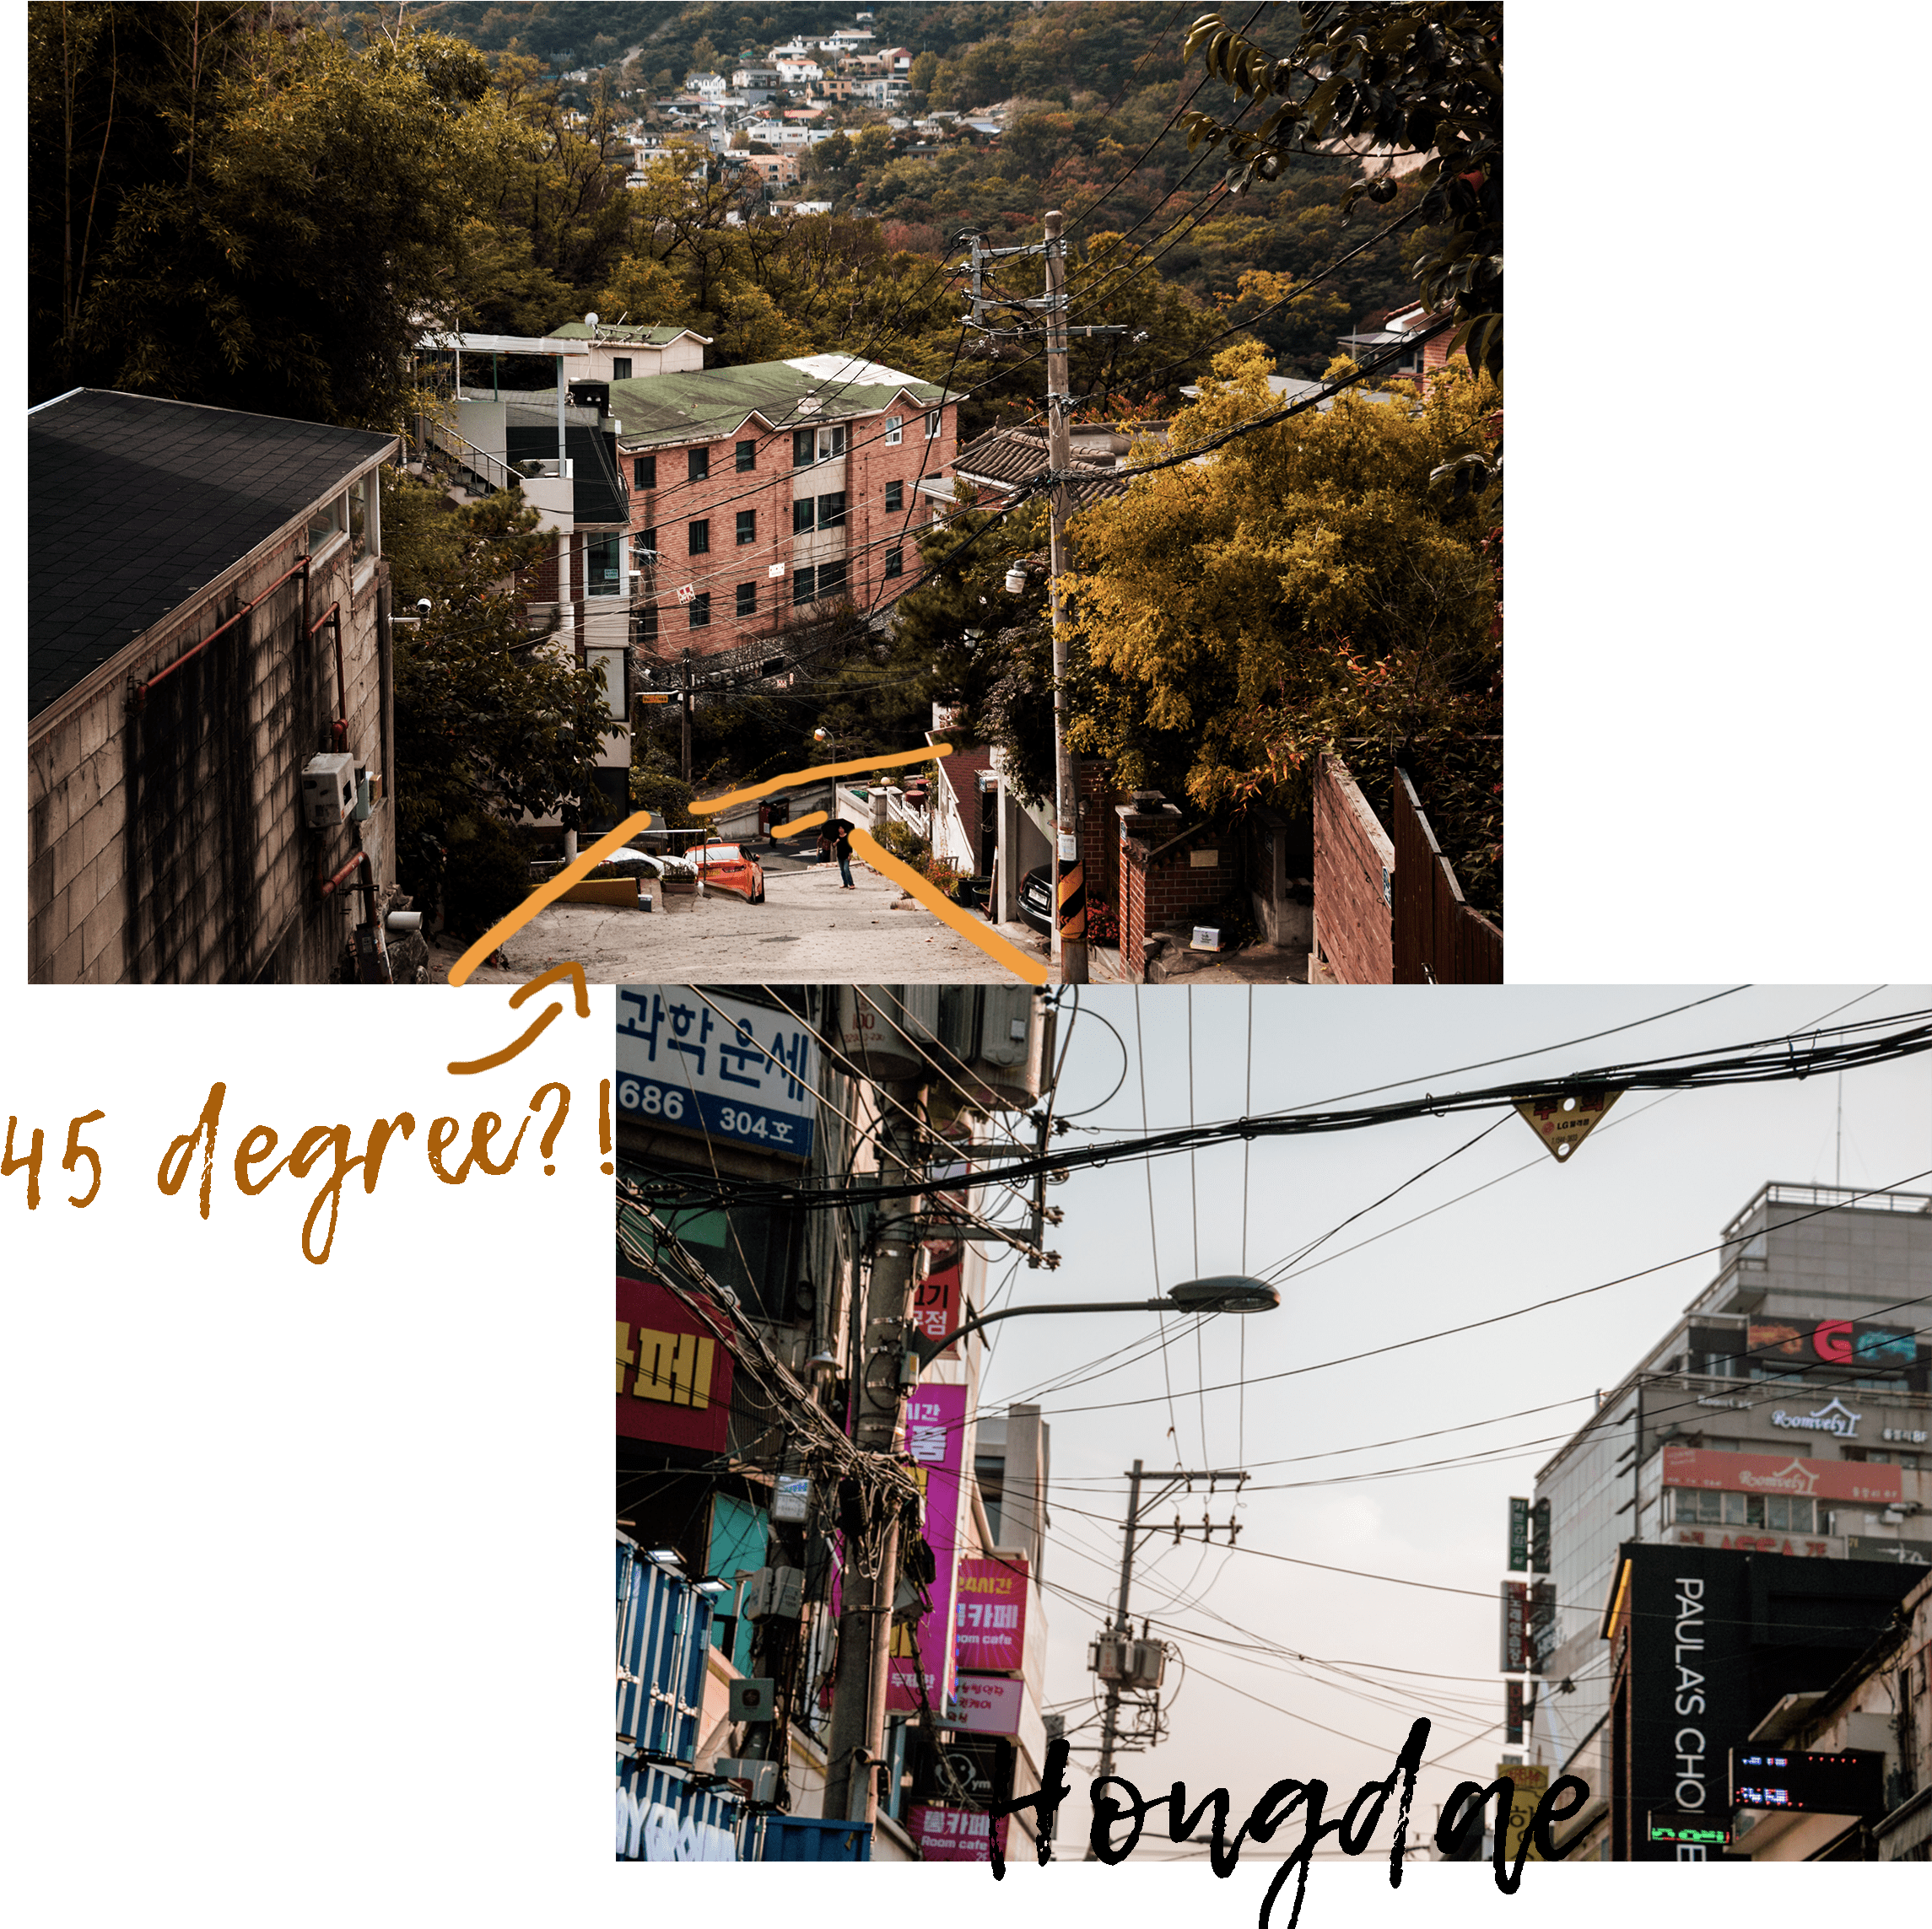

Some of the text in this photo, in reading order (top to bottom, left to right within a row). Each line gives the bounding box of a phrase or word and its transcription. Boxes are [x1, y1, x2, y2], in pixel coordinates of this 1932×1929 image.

[617, 990, 808, 1102] 과학운세
[618, 1080, 684, 1119] 686
[720, 1107, 793, 1144] 304호
[1676, 1578, 1707, 1862] PAULA'S CHOIE
[924, 1811, 990, 1836] 룸카페
[921, 1835, 989, 1851] Room cafe
